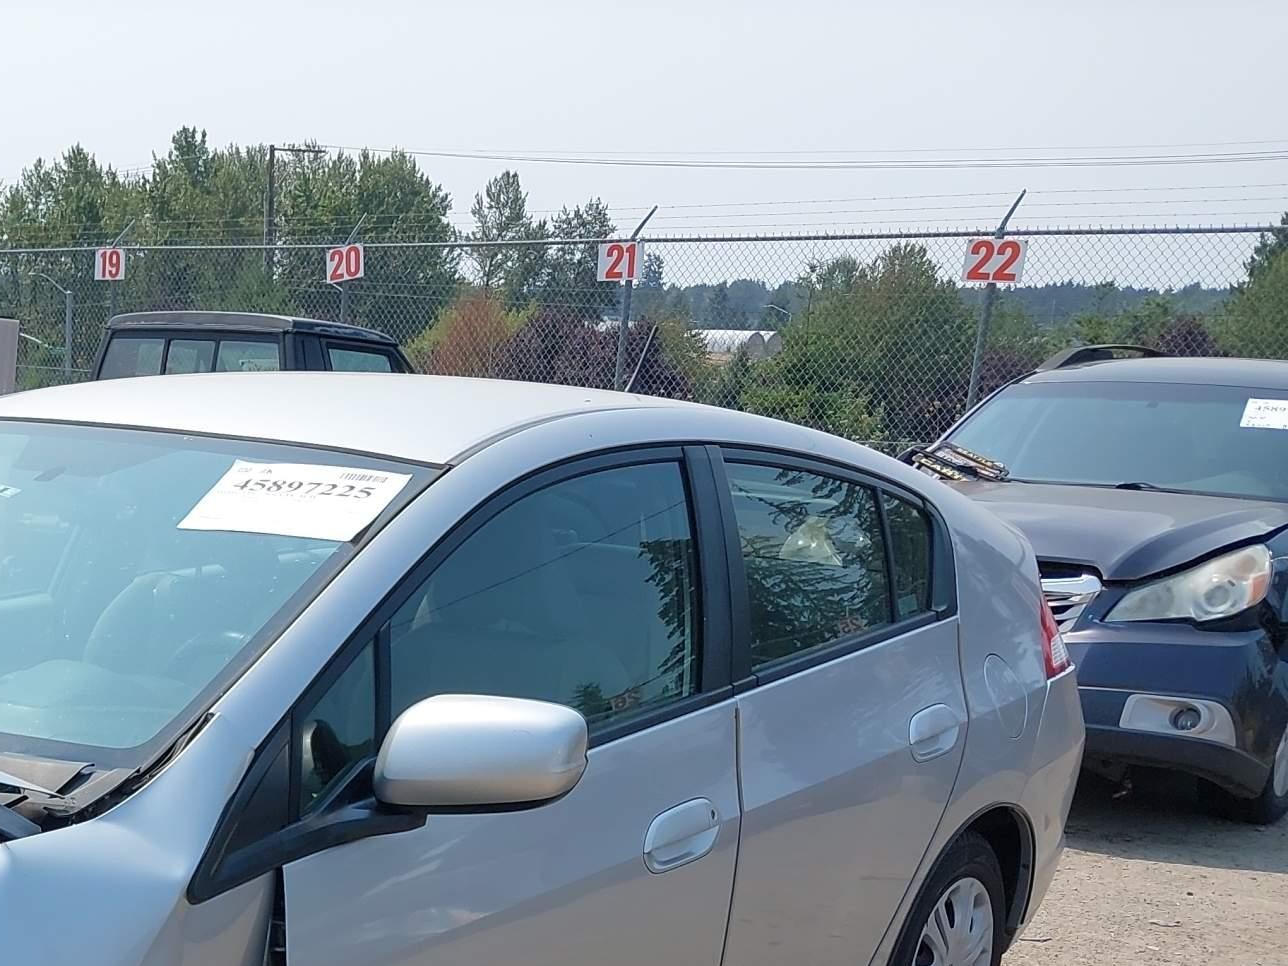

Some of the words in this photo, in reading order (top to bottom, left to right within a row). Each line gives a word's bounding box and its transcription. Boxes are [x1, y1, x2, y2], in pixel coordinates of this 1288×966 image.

[101, 250, 120, 278] 19
[330, 246, 360, 281] 20
[605, 244, 636, 279] 21
[967, 240, 1020, 281] 22
[233, 478, 376, 499] 45897225
